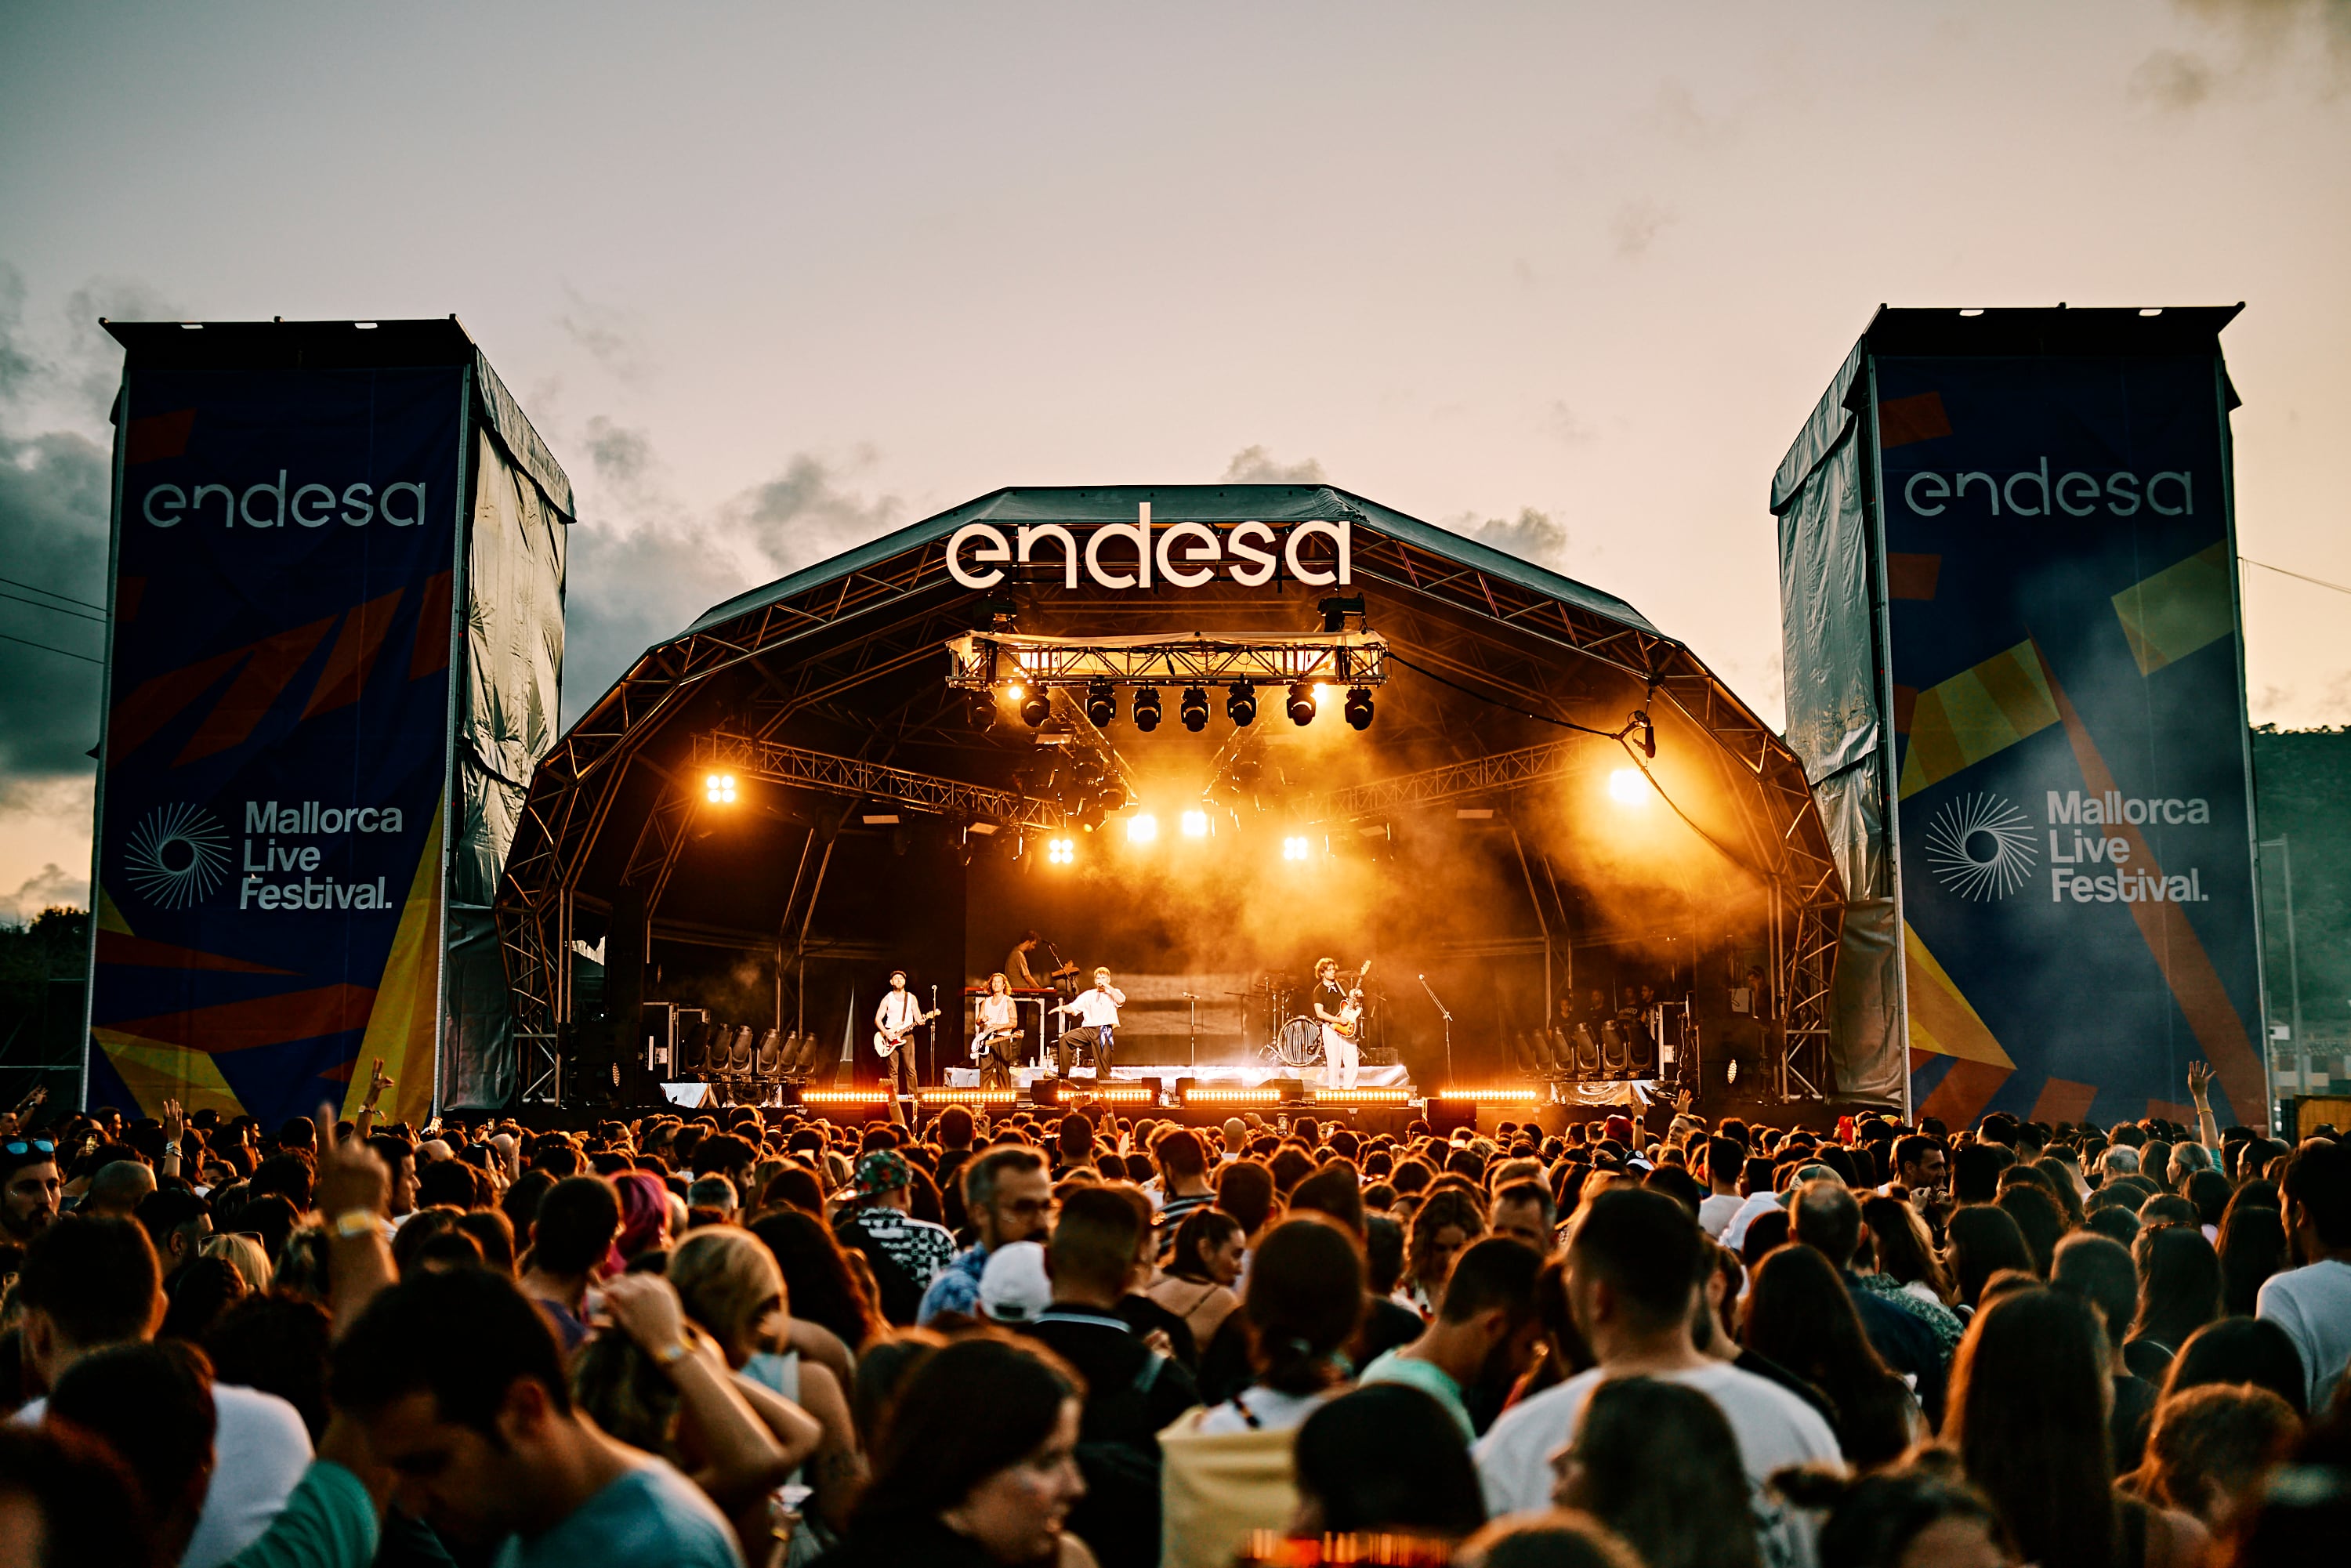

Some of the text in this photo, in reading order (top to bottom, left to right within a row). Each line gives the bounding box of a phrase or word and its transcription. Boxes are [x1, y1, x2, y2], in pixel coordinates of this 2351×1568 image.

[143, 469, 426, 528] endesa
[1904, 457, 2193, 516] endesa
[946, 502, 1350, 589] endesa
[245, 801, 402, 833] Mallorca
[2047, 790, 2209, 824] Mallorca
[243, 839, 321, 871] Live
[2050, 829, 2130, 864] Live
[240, 876, 392, 910] Festival.
[2051, 868, 2208, 903] Festival.
